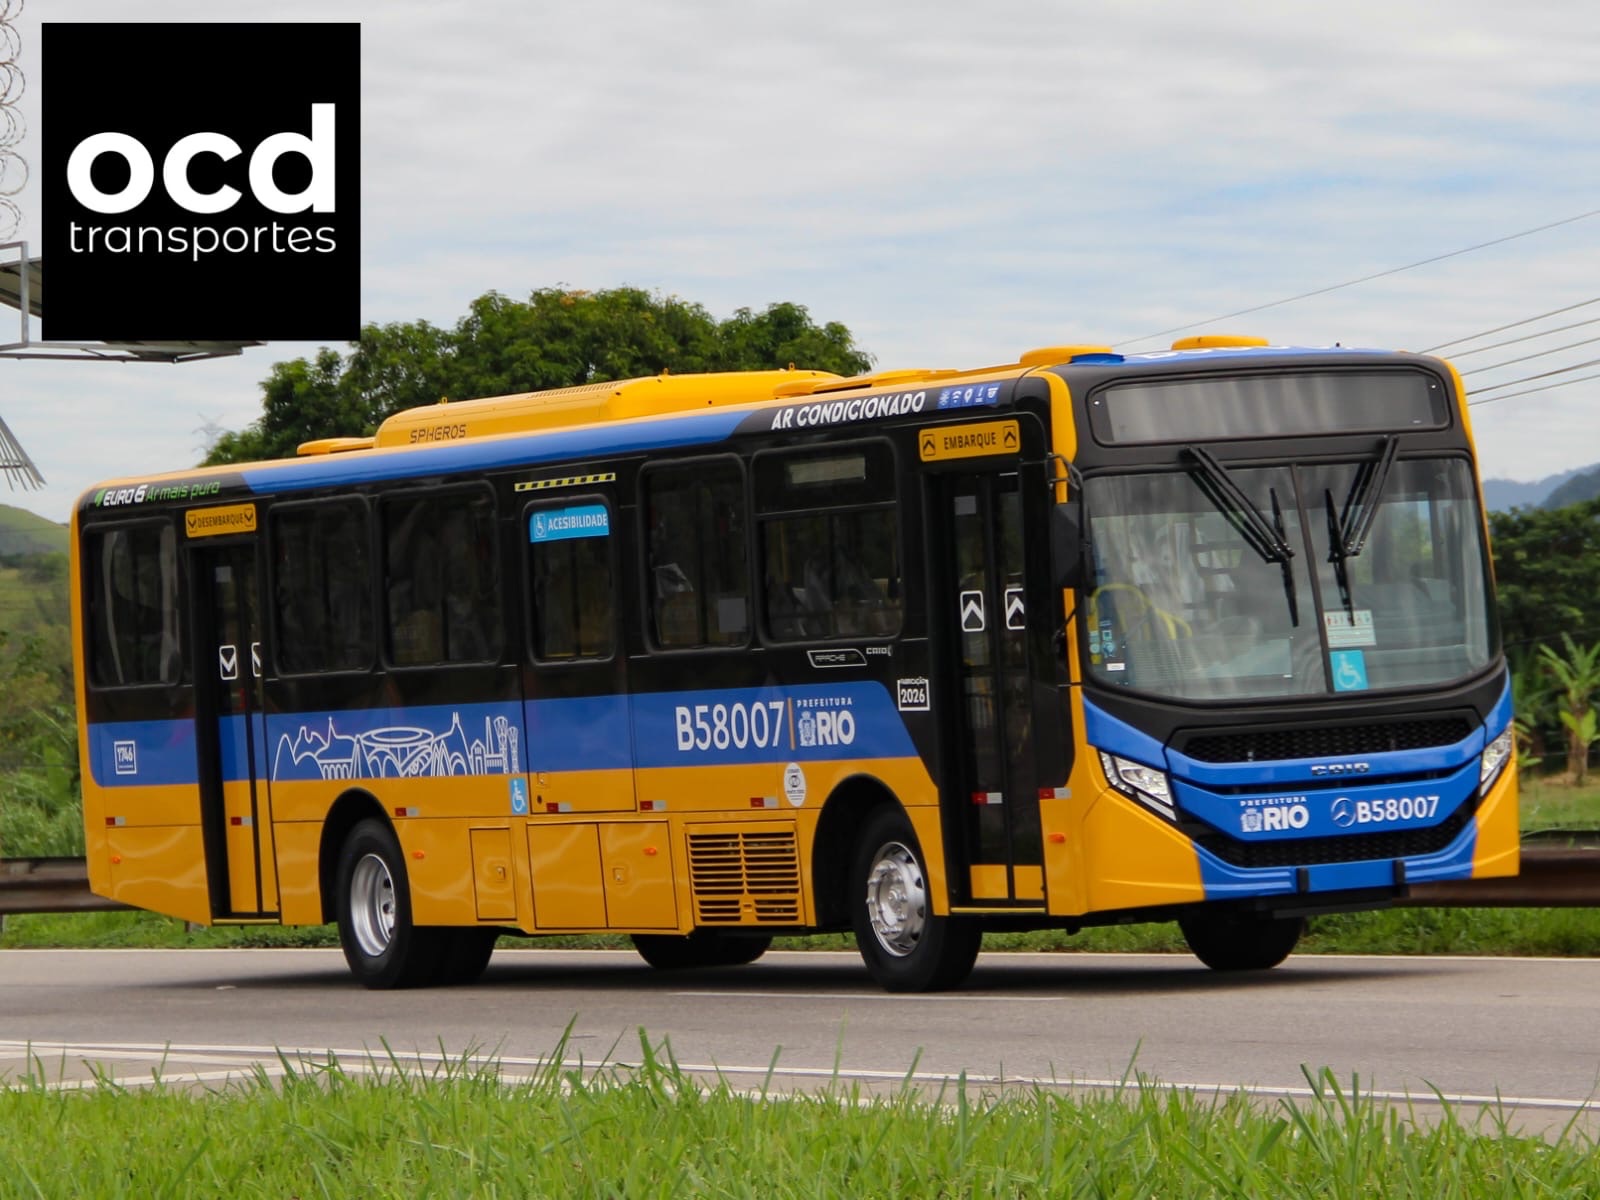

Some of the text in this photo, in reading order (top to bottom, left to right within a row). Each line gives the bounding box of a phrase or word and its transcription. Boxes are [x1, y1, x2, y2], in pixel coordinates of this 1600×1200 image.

[771, 391, 926, 430] AR CONDICIONADO
[409, 423, 467, 444] SPHEROS
[943, 431, 997, 449] EMBARQUE
[160, 482, 188, 500] mais
[190, 481, 220, 500] puro
[197, 511, 244, 529] DESEMBARQUE
[547, 513, 608, 531] ACESIBILIDADE
[797, 697, 852, 708] PREFEITURA
[900, 688, 926, 703] 2026
[676, 701, 784, 750] B58007
[816, 710, 855, 745] RIO
[1240, 796, 1307, 806] PREFEITURA
[1356, 796, 1440, 823] B58007
[1263, 805, 1309, 831] RIO
